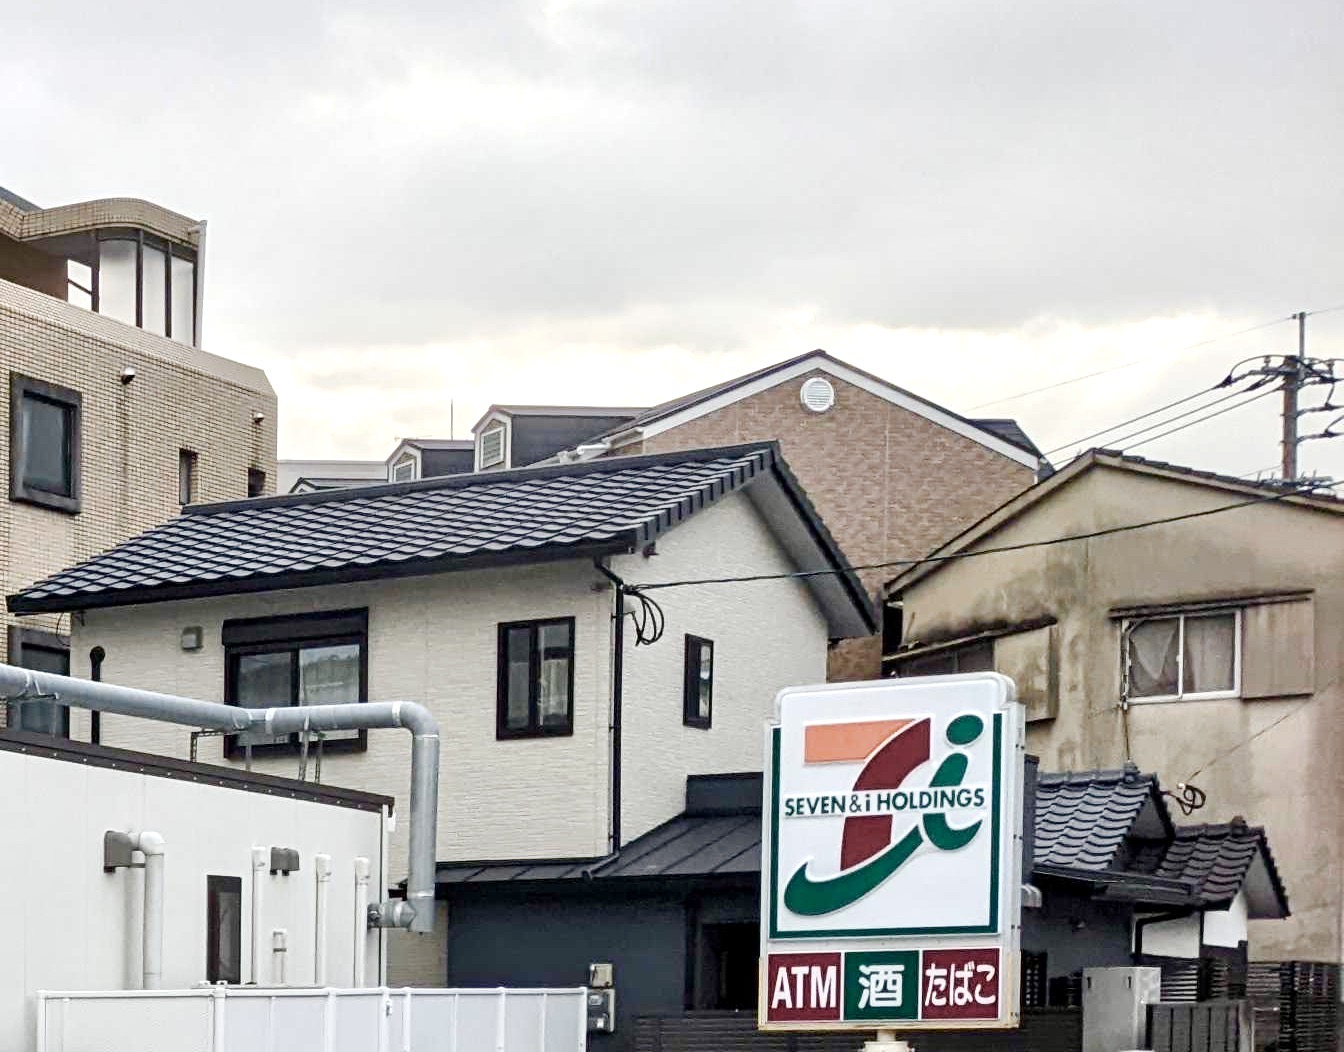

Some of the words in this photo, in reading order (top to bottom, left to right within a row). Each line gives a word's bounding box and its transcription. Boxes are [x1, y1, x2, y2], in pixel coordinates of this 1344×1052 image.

[784, 795, 847, 817] SEVEN
[849, 794, 862, 813] &
[877, 787, 985, 812] HOLDINGS
[771, 965, 837, 1009] ATM
[858, 963, 905, 1009] 酒
[924, 960, 996, 1007] たばこ
